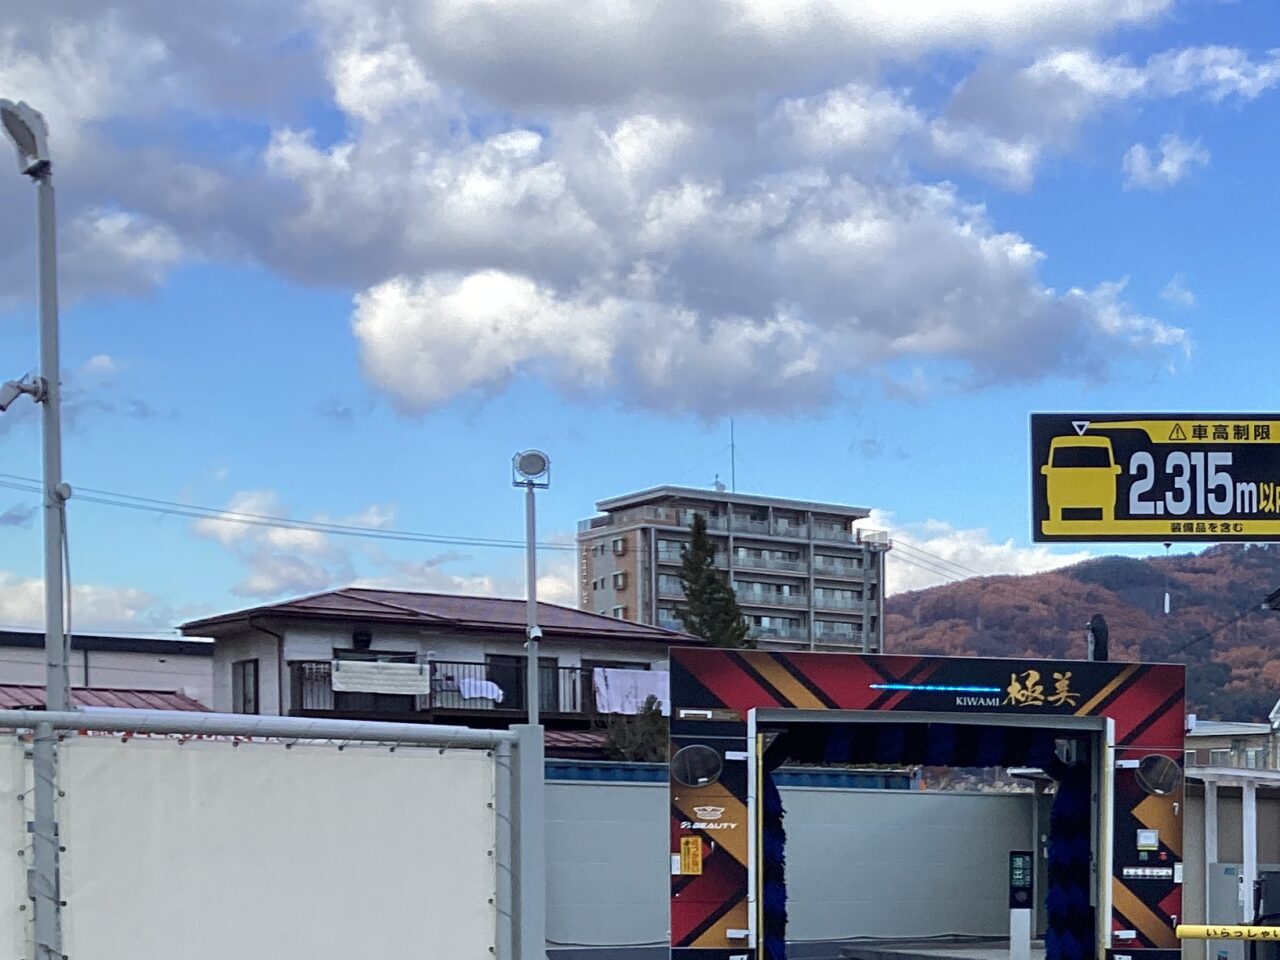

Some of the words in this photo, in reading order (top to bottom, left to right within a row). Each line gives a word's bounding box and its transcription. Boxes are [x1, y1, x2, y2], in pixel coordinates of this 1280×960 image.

[1192, 424, 1271, 441] 車高制限
[1170, 522, 1244, 533] 装備品を含む
[1001, 670, 1081, 707] 極美
[956, 696, 1000, 706] KIWAMI
